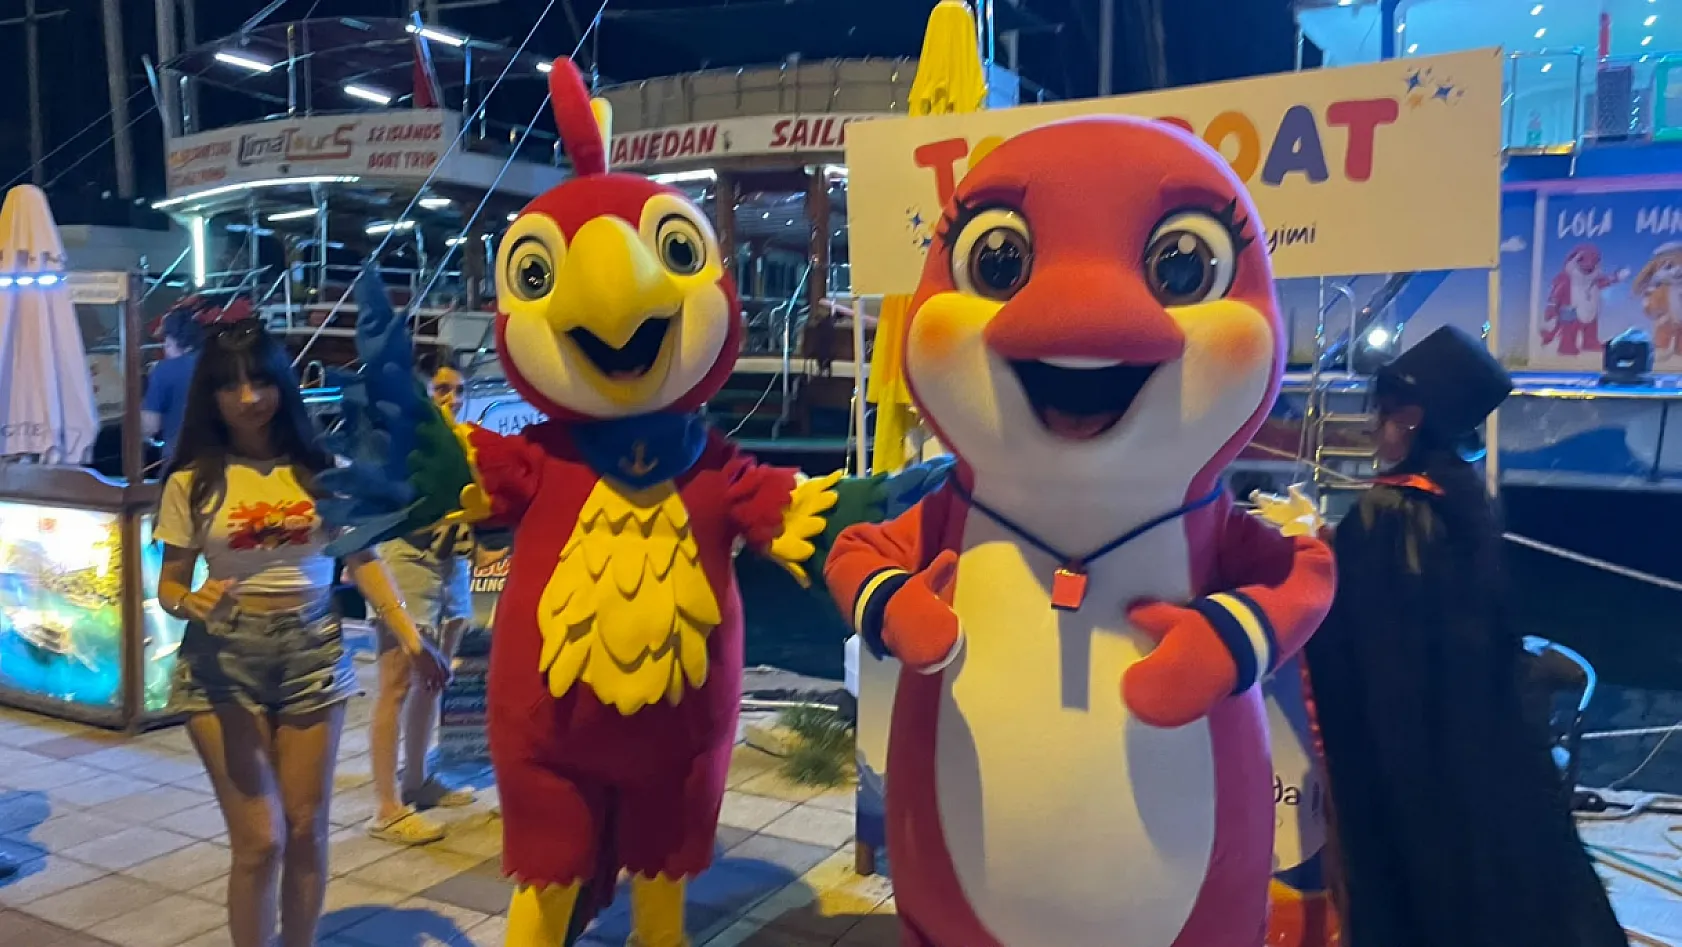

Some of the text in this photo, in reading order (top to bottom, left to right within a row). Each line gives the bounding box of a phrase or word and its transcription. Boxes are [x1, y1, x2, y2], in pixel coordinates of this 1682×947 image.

[1156, 97, 1400, 186] OAT
[368, 150, 438, 169] BOAT TRIP
[1557, 206, 1613, 239] LOLA
